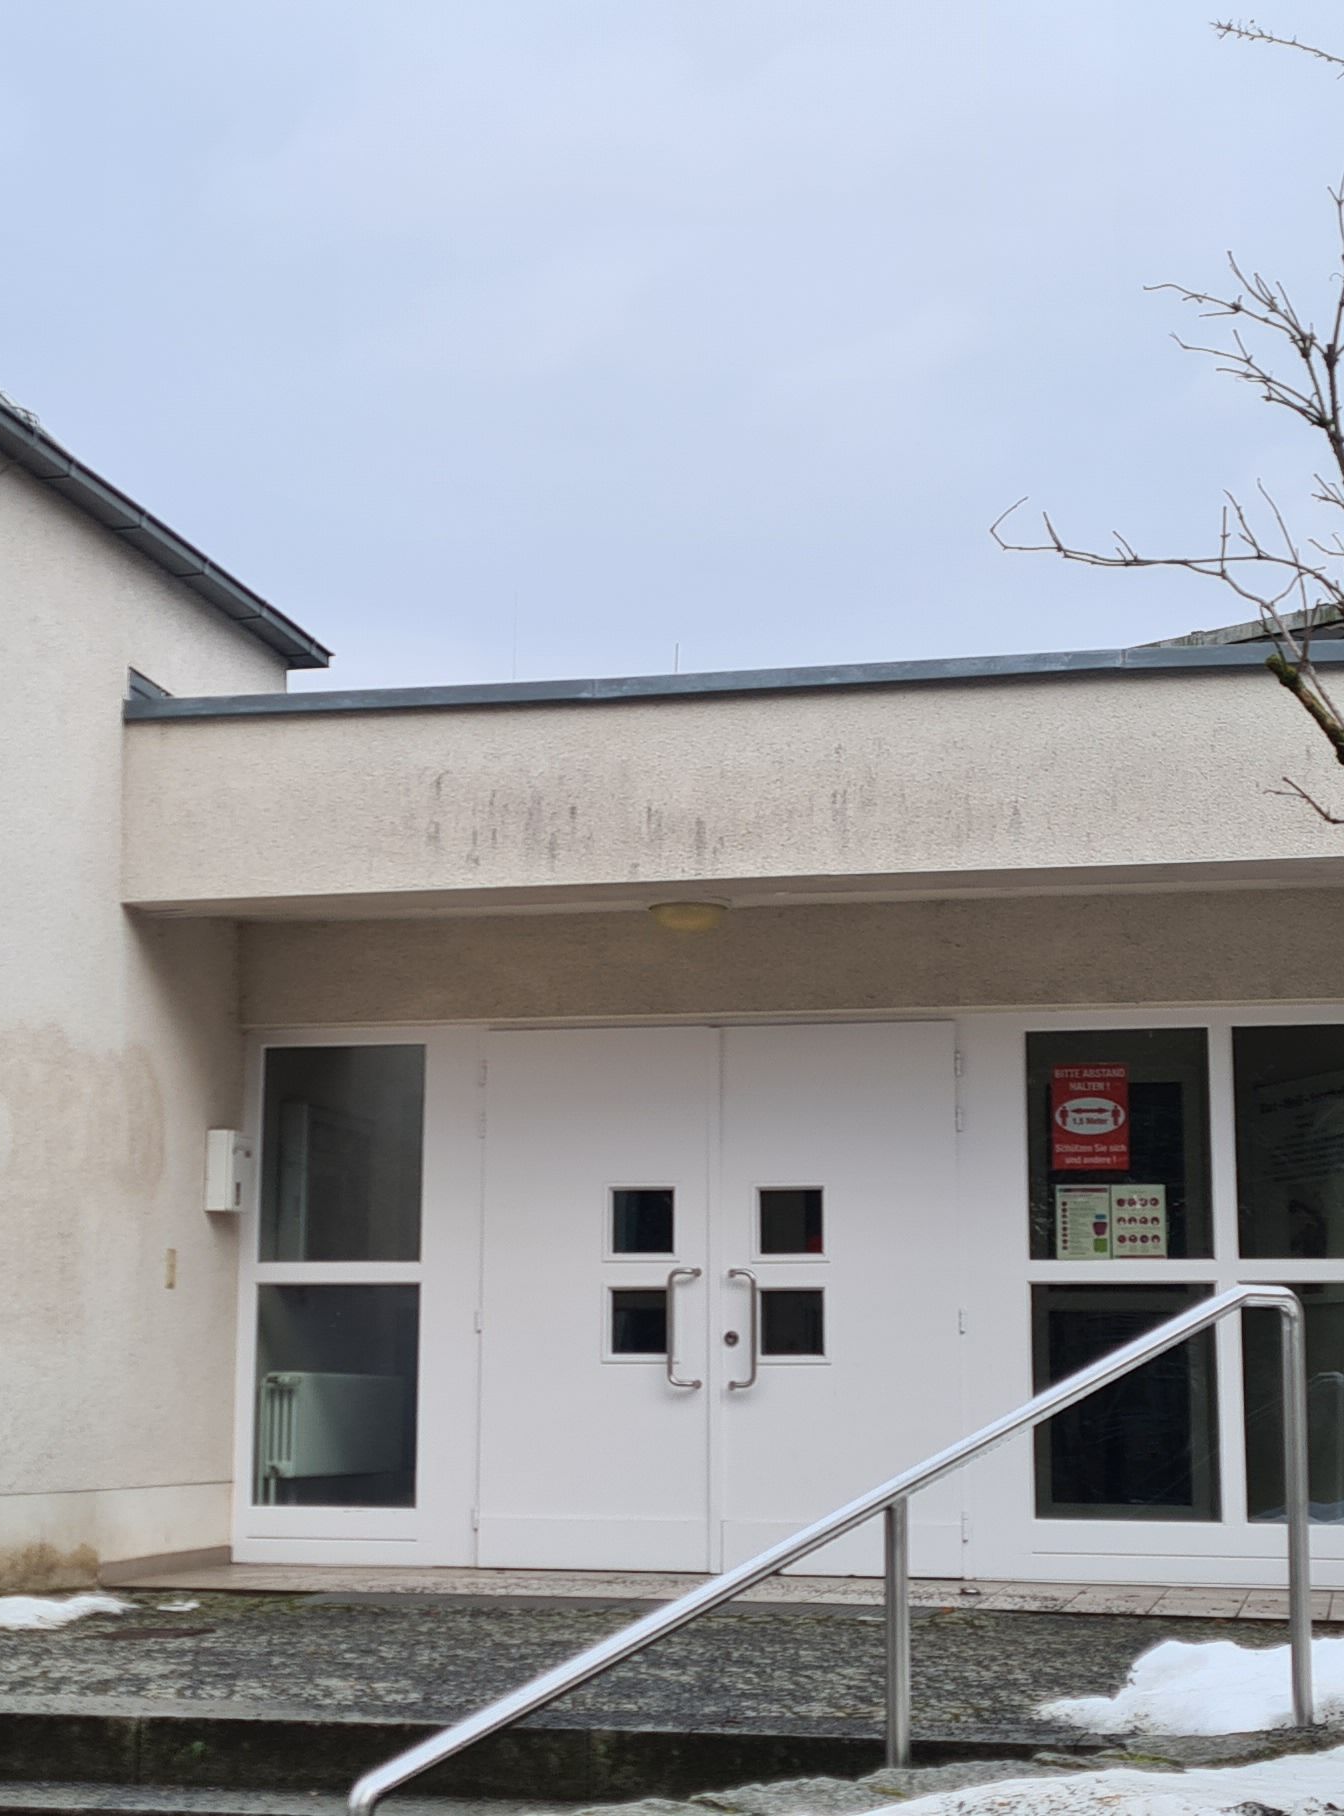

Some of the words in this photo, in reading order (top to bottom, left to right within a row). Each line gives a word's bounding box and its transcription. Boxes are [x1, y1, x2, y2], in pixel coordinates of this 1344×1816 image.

[1054, 1068, 1081, 1078] BITTE
[1082, 1068, 1125, 1078] ABSTAND
[1069, 1082, 1104, 1091] HALTEN
[1086, 1117, 1109, 1125] Meter
[1055, 1143, 1093, 1152] Schützen
[1094, 1143, 1107, 1152] Sie
[1109, 1143, 1127, 1152] sich
[1065, 1156, 1082, 1164] und
[1083, 1156, 1111, 1164] andere
